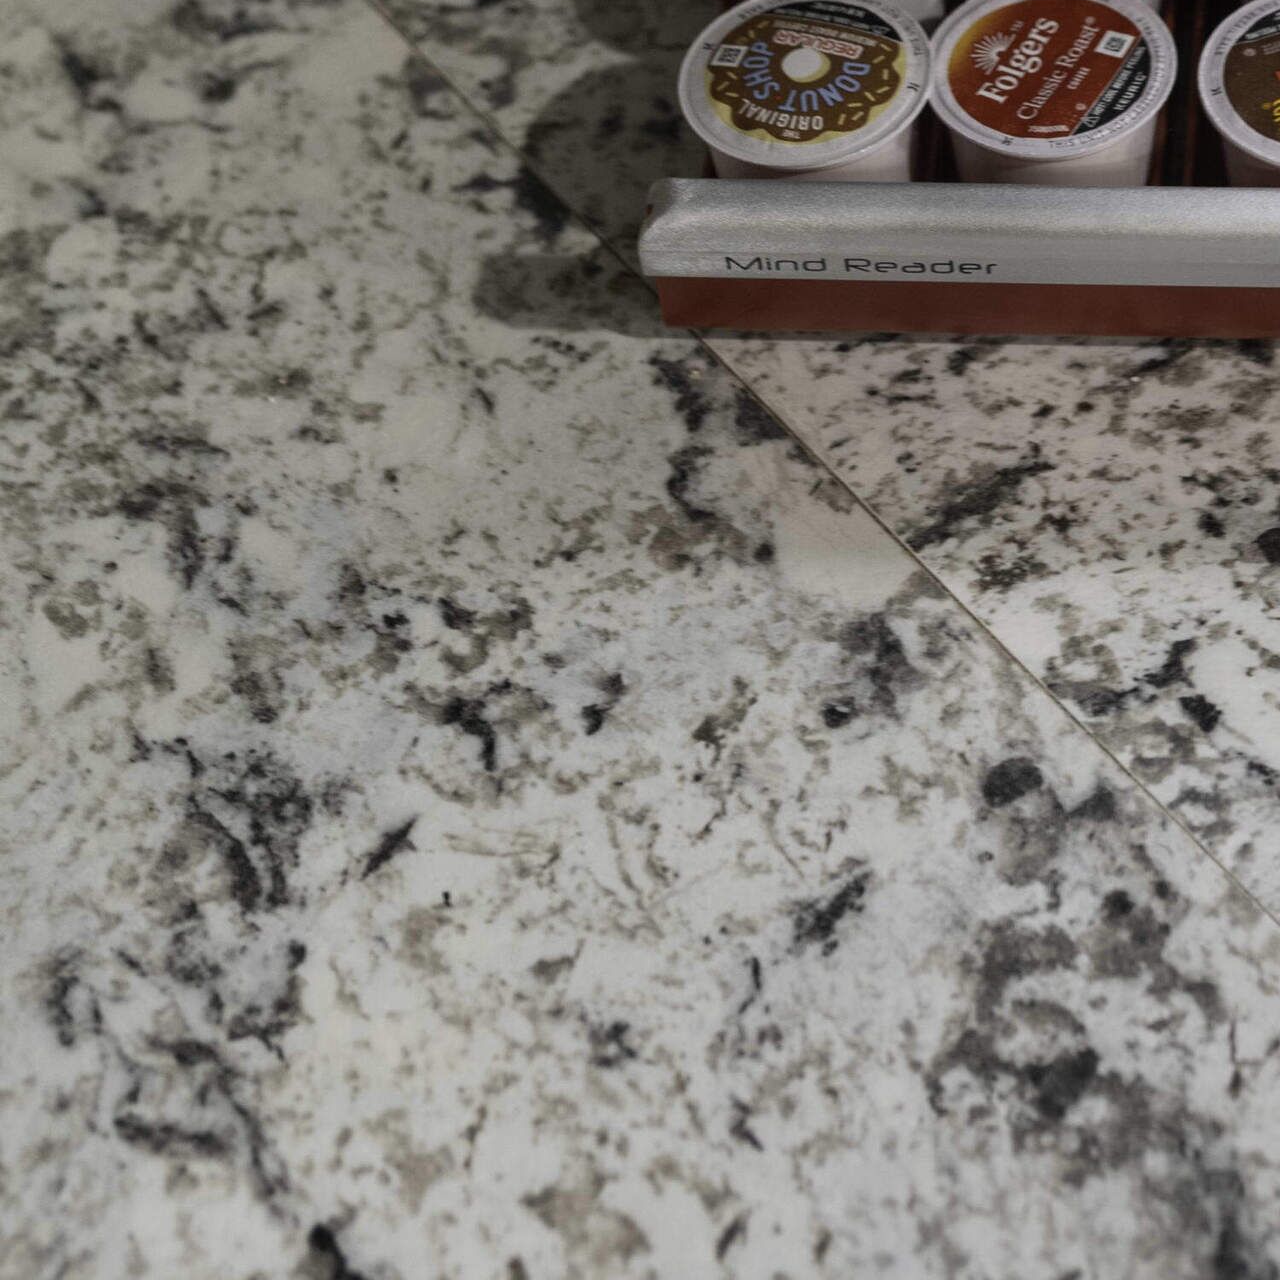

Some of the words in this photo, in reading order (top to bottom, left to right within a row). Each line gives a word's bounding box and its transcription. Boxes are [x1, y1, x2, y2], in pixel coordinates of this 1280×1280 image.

[776, 33, 861, 56] REGULAR
[974, 15, 1059, 103] Folgers
[742, 41, 779, 100] SHOP
[776, 60, 871, 112] DONUT
[1112, 73, 1148, 112] KEURIG
[736, 98, 823, 131] ORIGINAL
[1016, 67, 1067, 120] Classic
[725, 255, 827, 271] Mind
[843, 257, 998, 275] Reader
